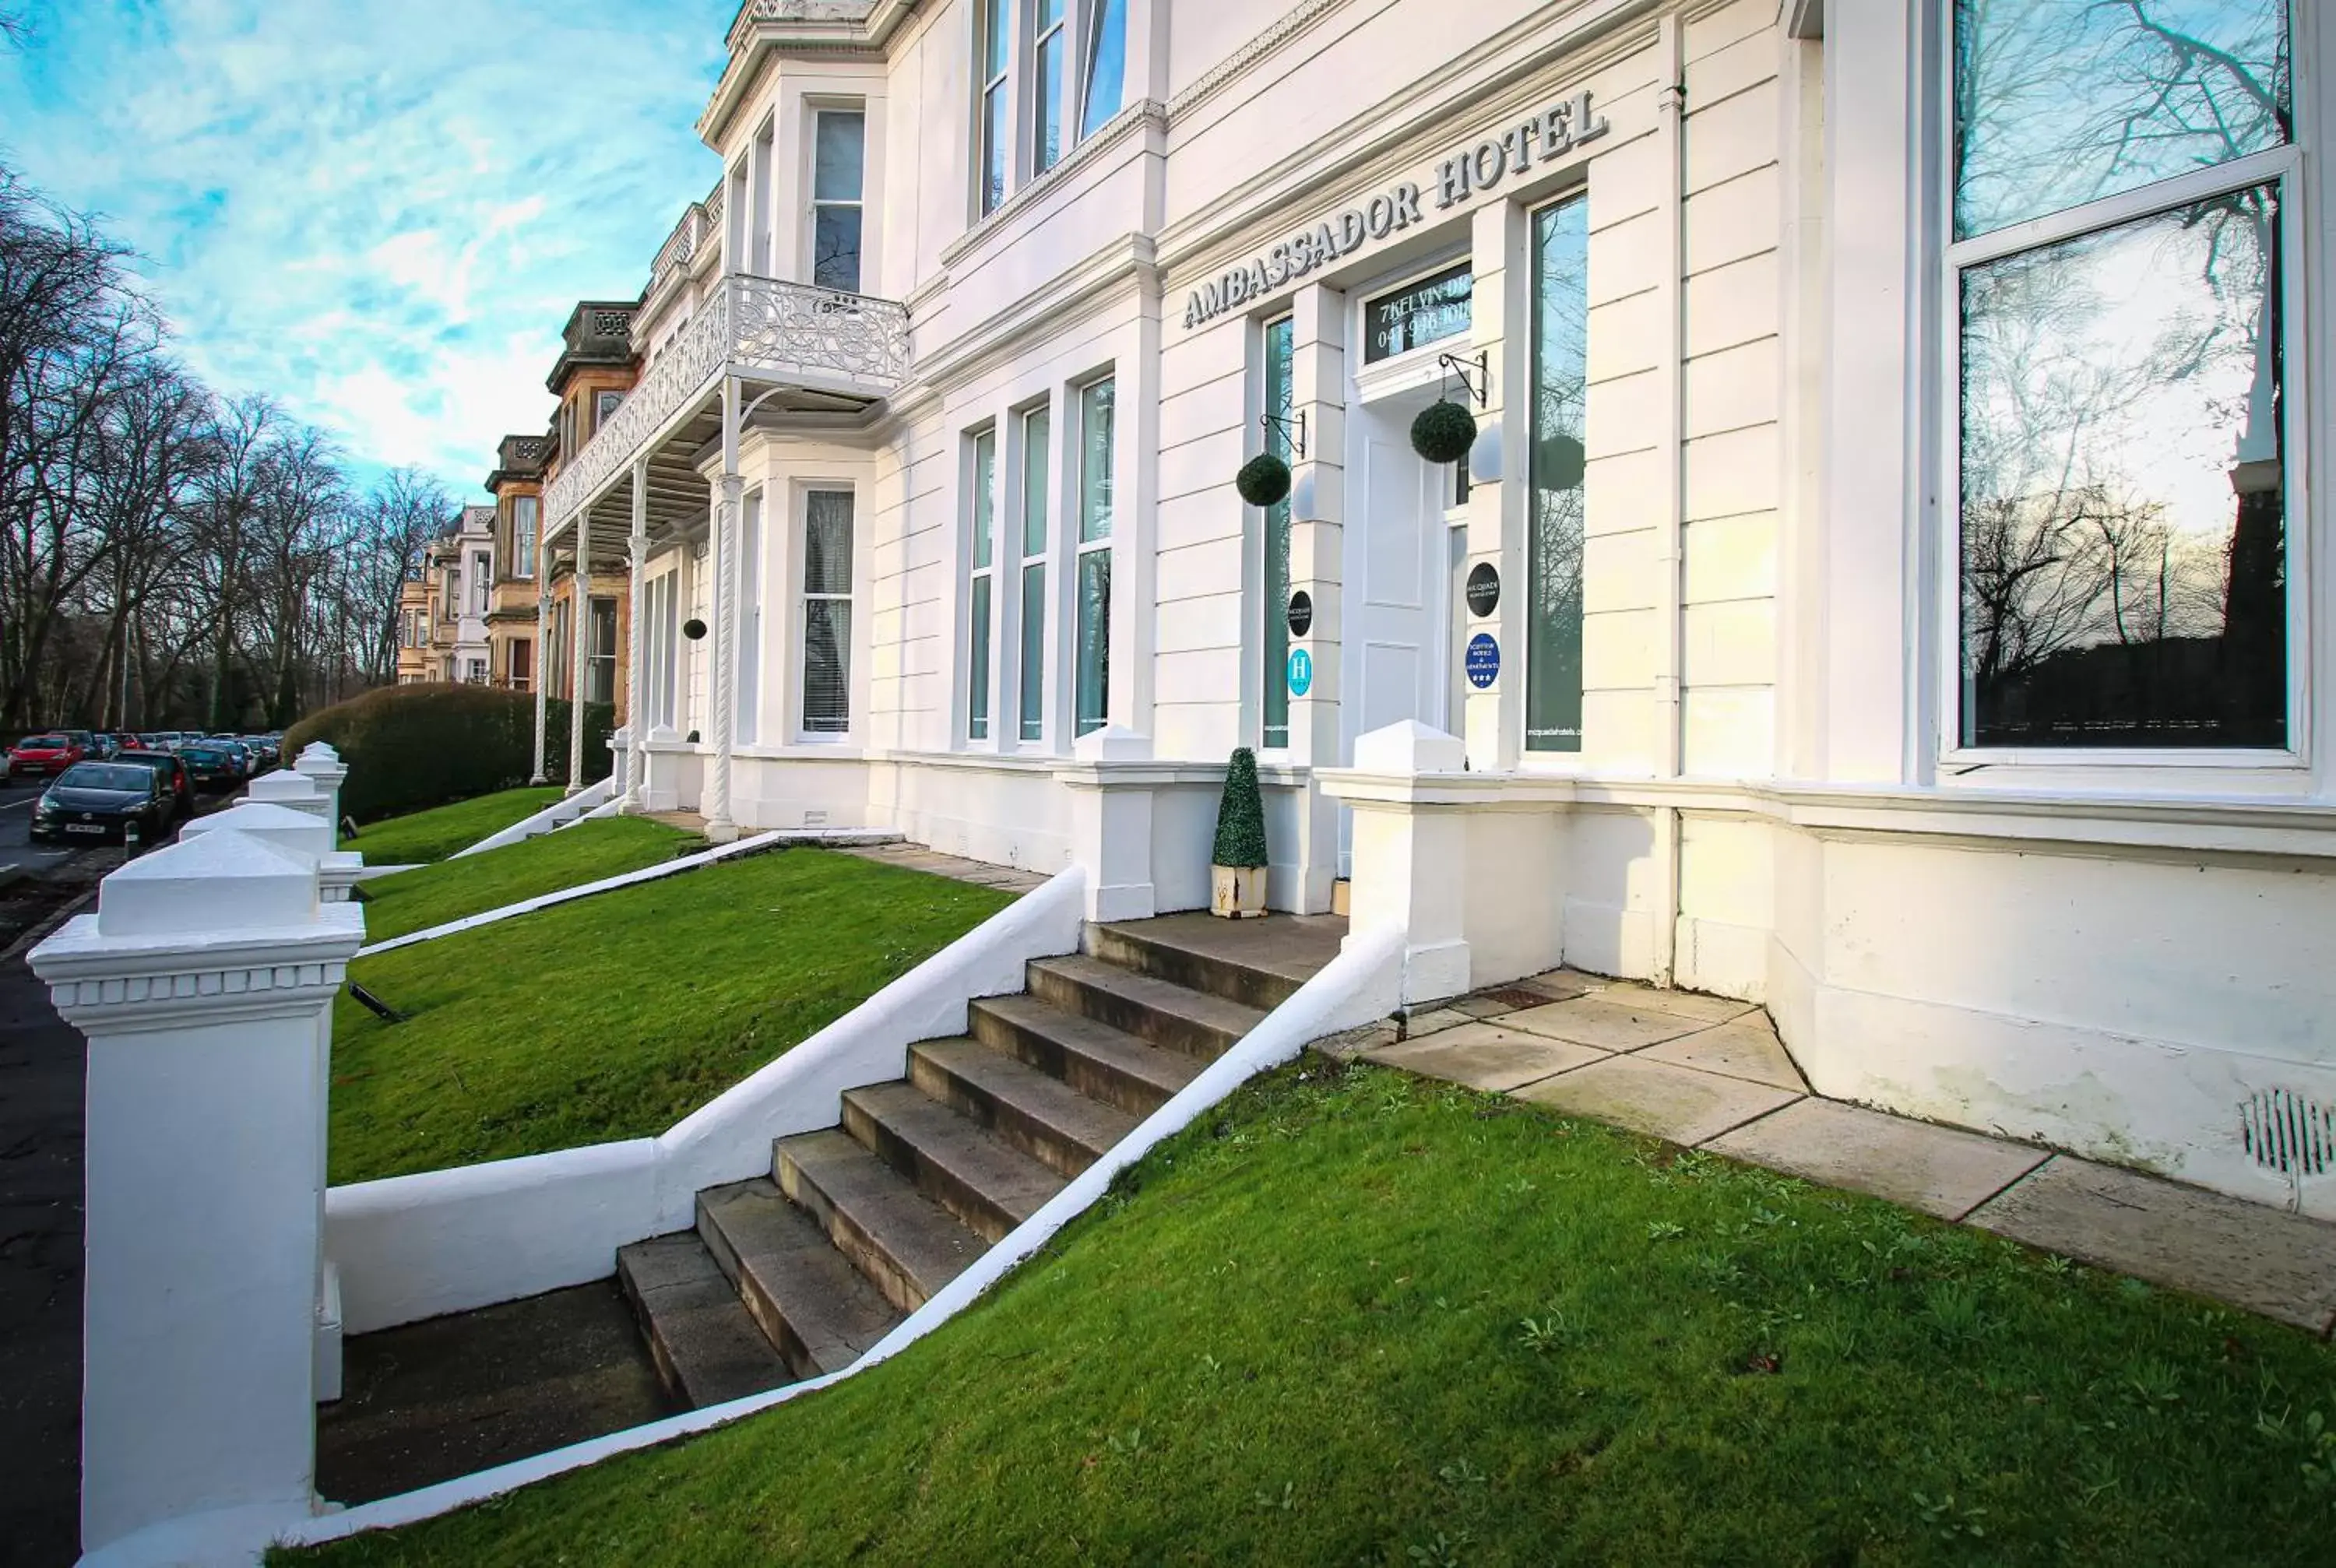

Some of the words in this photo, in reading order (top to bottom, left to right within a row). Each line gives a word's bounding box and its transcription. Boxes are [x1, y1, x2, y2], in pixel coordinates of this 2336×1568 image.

[1183, 181, 1423, 329] AMBASSADOR
[1434, 90, 1609, 209] HOTEL
[1292, 656, 1306, 680] H
